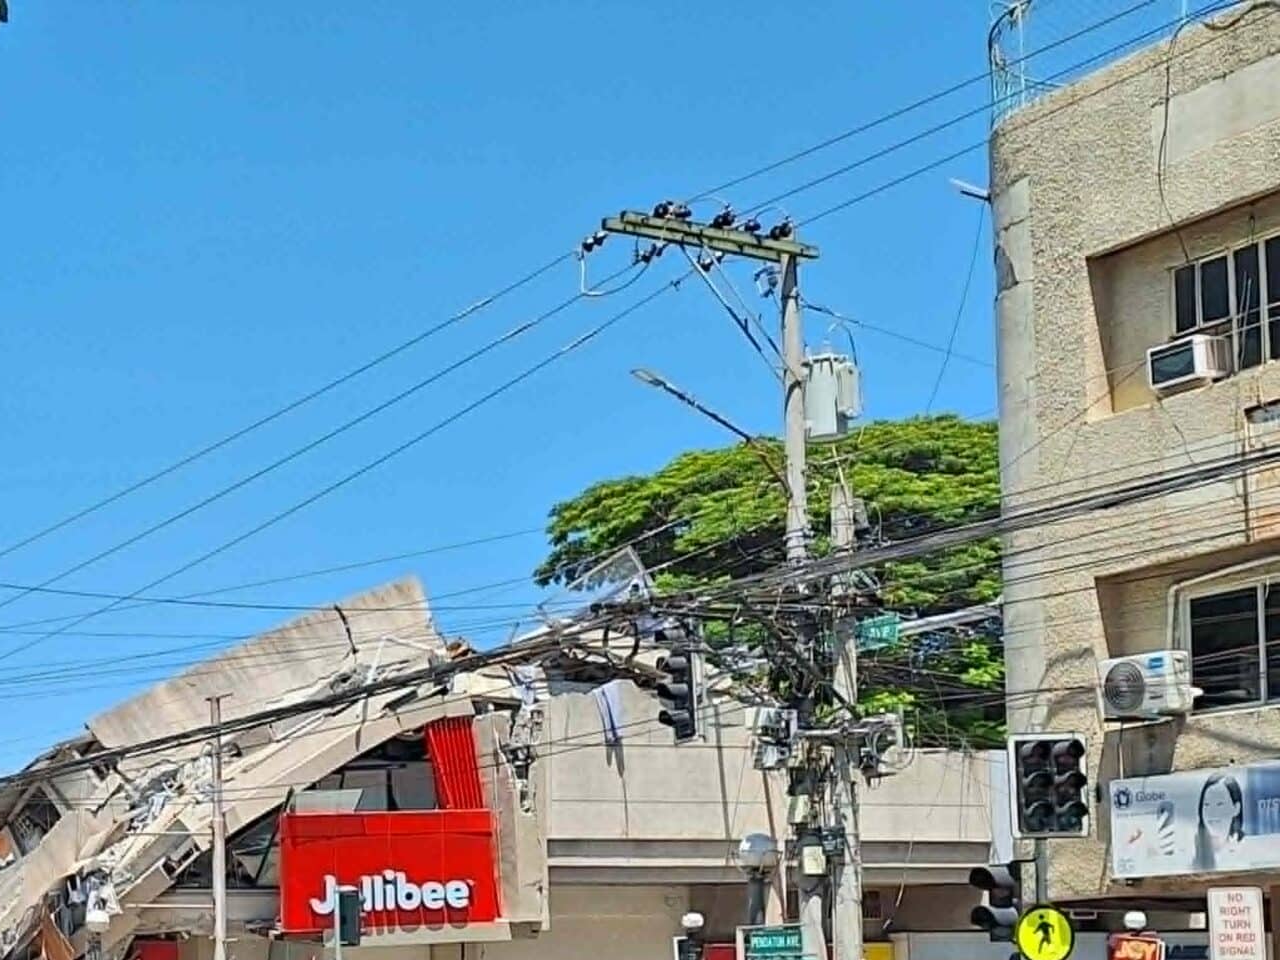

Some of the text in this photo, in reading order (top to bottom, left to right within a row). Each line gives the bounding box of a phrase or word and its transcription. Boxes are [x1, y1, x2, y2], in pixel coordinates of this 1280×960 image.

[1135, 790, 1166, 802] Globe
[309, 869, 471, 915] Jllibee
[1227, 893, 1243, 902] NO
[1219, 906, 1252, 916] RIGHT
[1223, 920, 1251, 930] TURN
[1219, 933, 1256, 942] ON RED
[1219, 947, 1256, 956] SIGNAL
